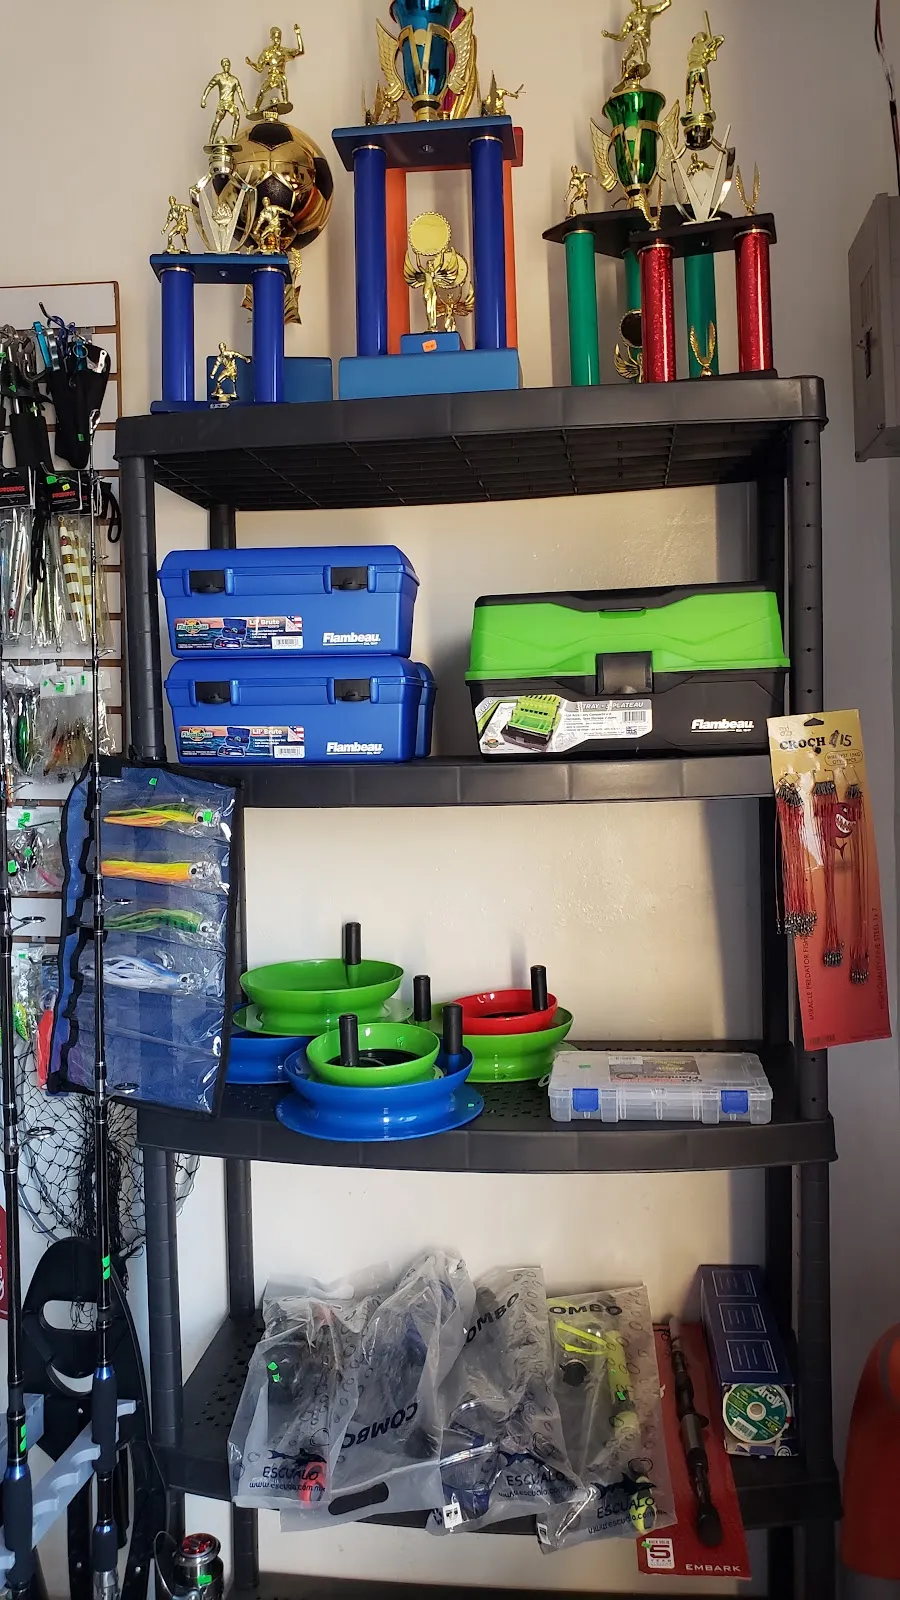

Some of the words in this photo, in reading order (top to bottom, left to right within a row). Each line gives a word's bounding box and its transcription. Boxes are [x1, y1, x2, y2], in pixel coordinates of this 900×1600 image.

[549, 1303, 623, 1316] OMBO
[465, 1292, 519, 1343] OMBO
[262, 1466, 319, 1480] ESCUALO
[597, 1497, 655, 1519] ESCUALO
[650, 1545, 670, 1558] 5
[685, 1563, 741, 1572] EMBARK
